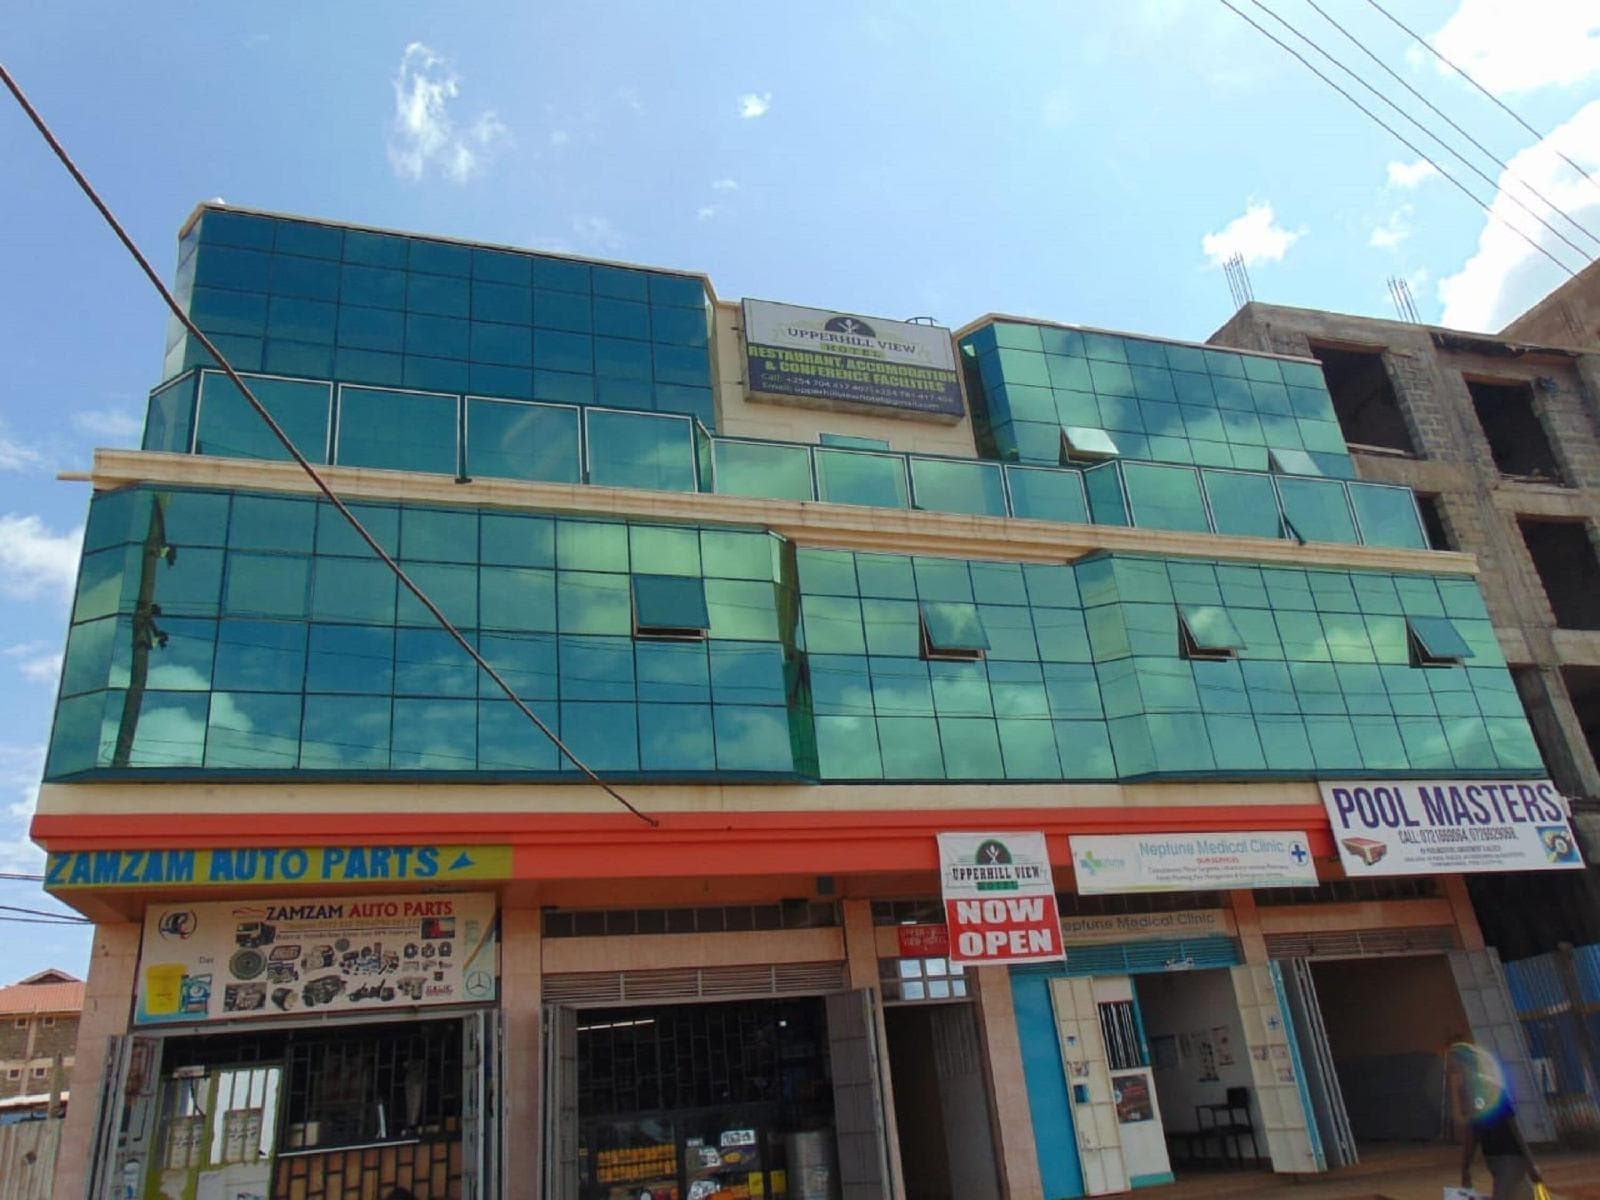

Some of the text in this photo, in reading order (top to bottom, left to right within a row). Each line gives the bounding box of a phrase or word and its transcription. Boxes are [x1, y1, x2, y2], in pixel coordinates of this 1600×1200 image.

[787, 327, 916, 354] UPPERHILL VIEW
[765, 361, 945, 392] & CONFERENCE FACILITIES
[1332, 784, 1562, 829] POOL MASTERS
[1139, 839, 1284, 857] Neptune Medical Clinic
[46, 847, 439, 884] ZAMZAM AUTO PARTS
[952, 866, 1040, 881] UPPERHILL VIEW
[266, 901, 452, 920] ZAMZAM AUTO PARTS
[957, 899, 1044, 924] NOW
[1062, 912, 1215, 932] eptune Medical Clinic
[959, 929, 1052, 956] OPEN
